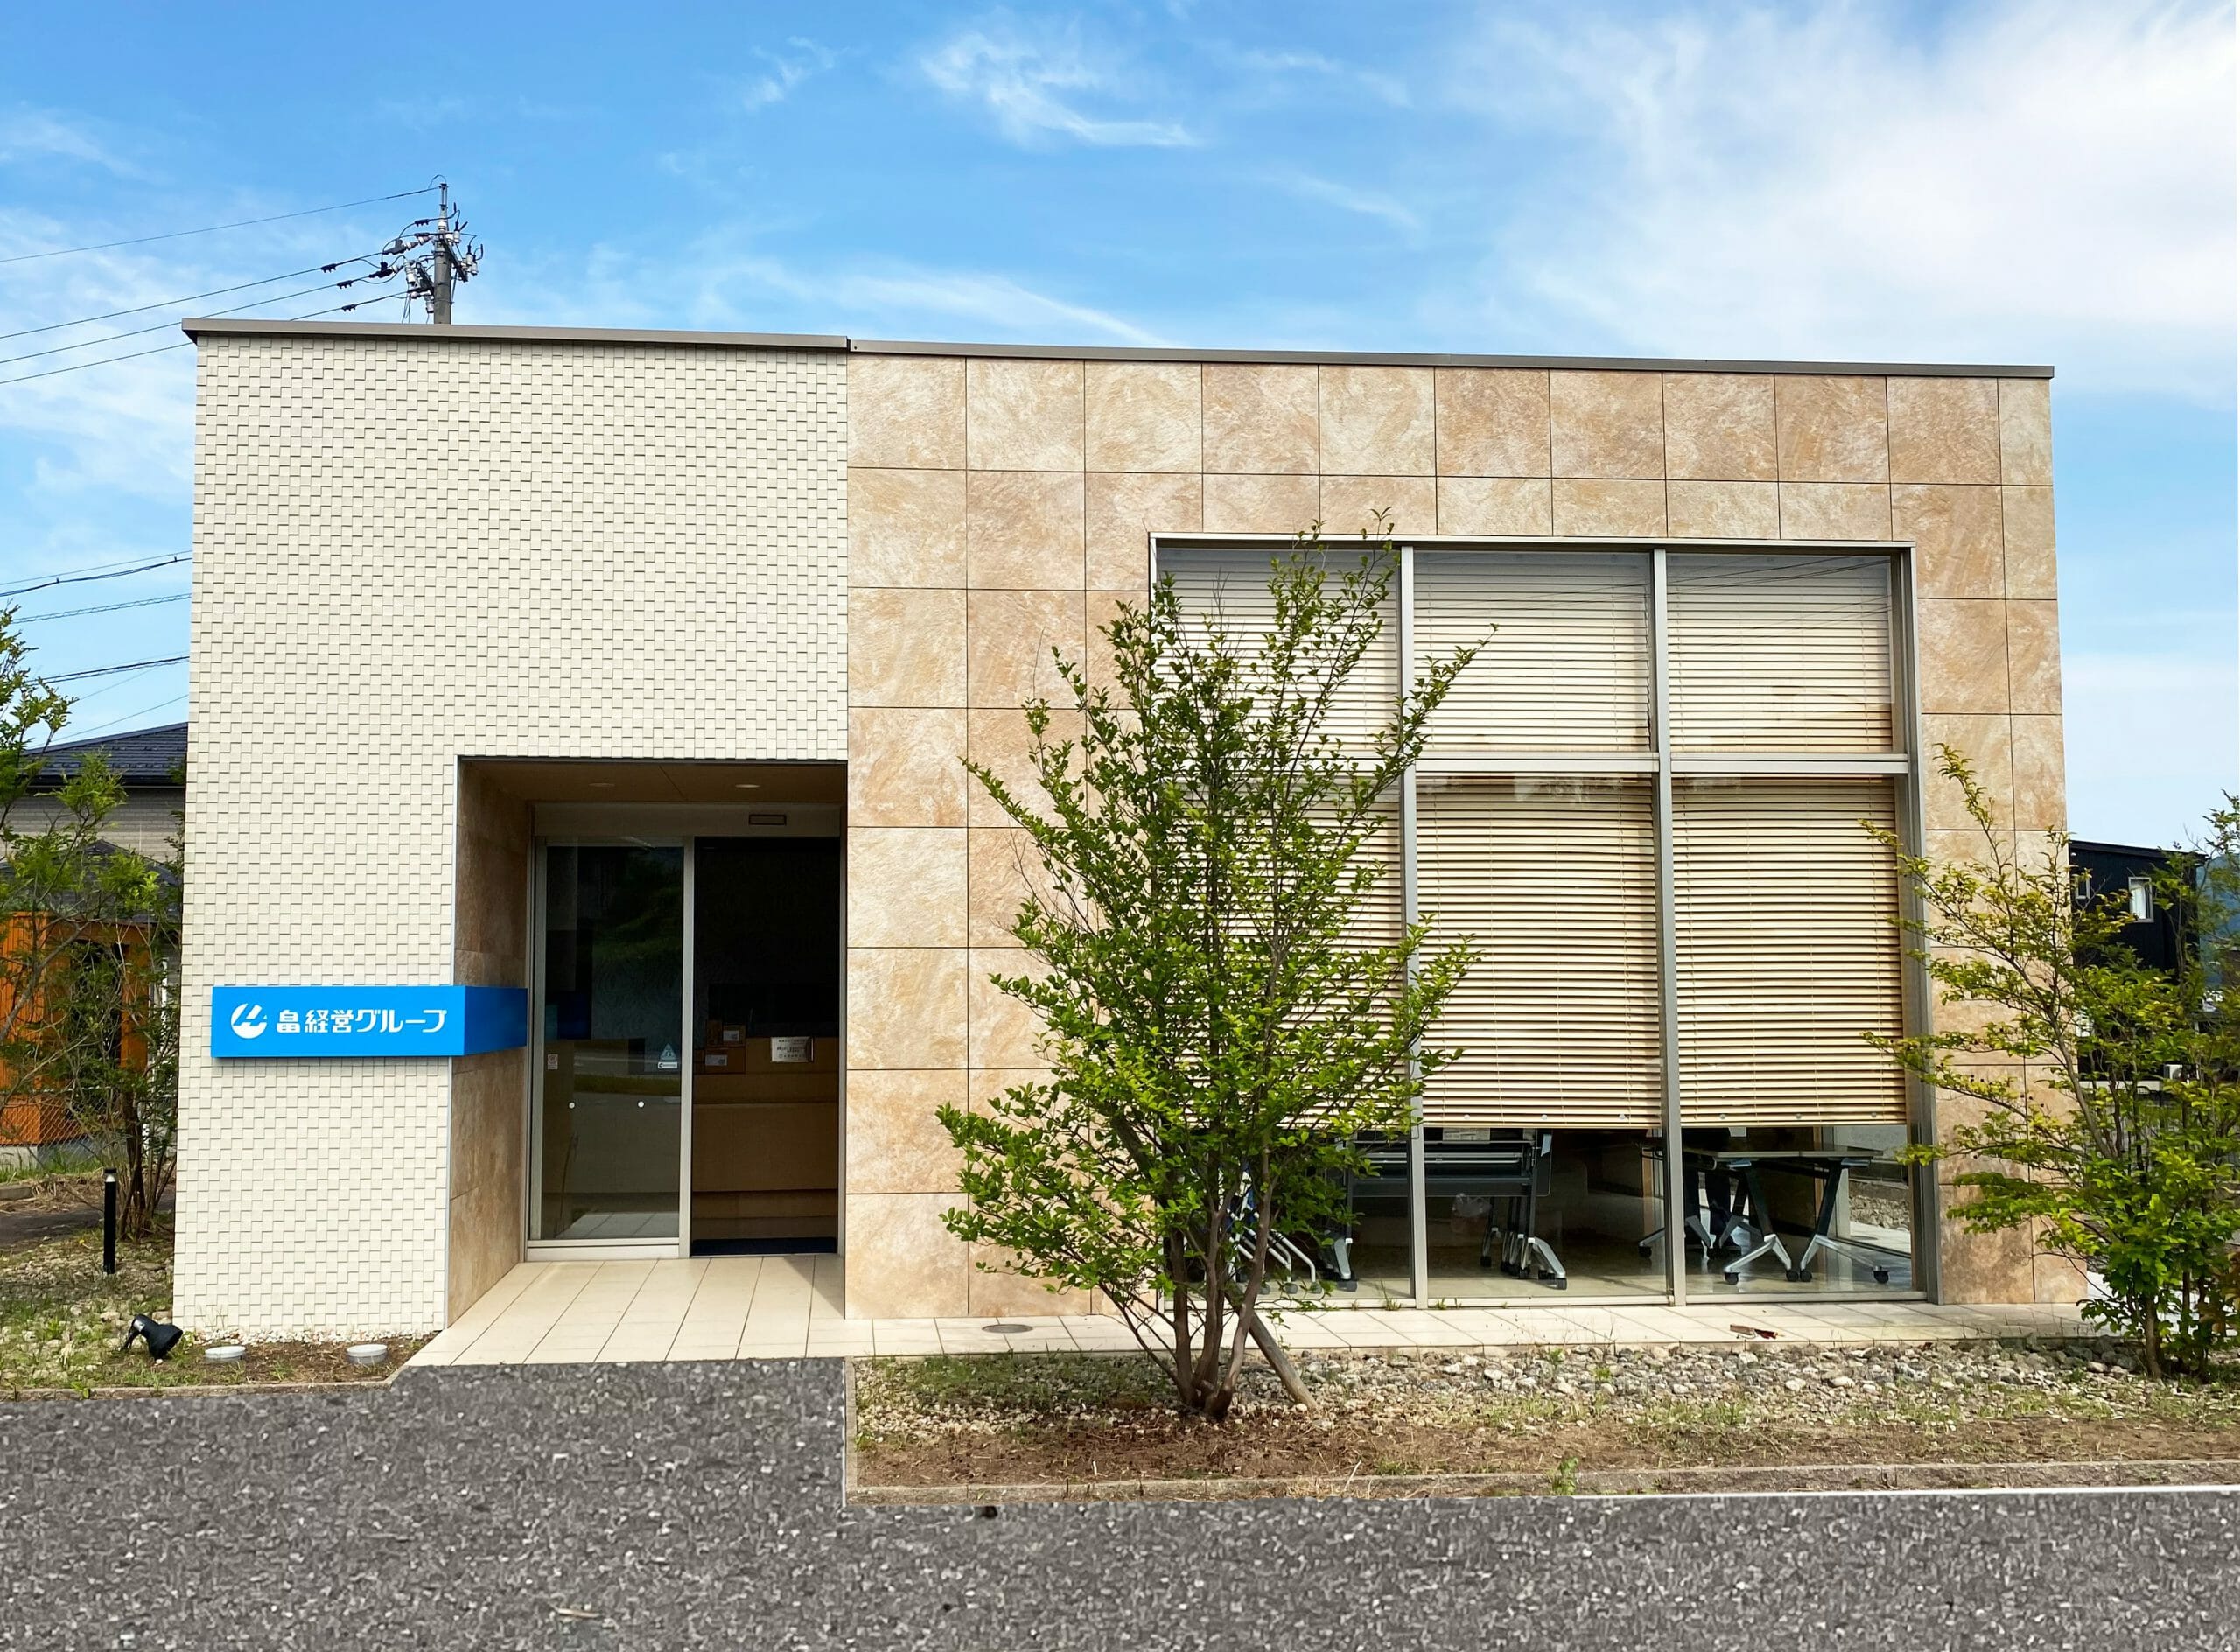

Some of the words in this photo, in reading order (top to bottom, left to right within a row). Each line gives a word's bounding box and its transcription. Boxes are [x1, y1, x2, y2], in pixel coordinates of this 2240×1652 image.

[276, 1009, 447, 1033] 畠経営グループ
